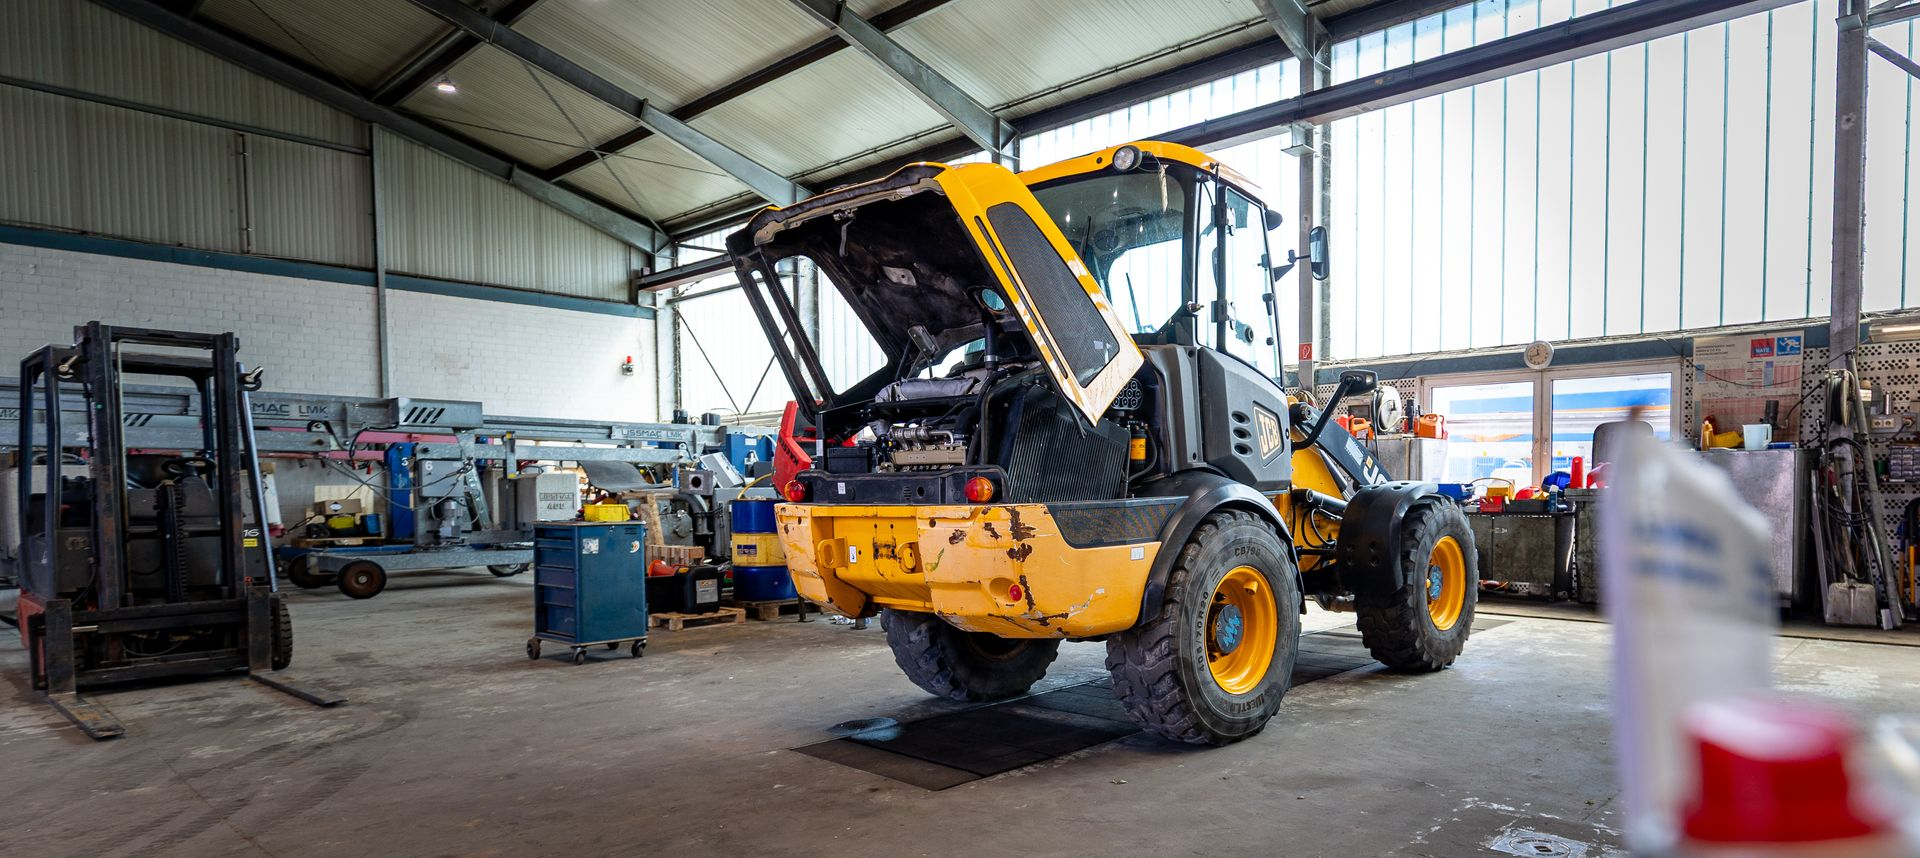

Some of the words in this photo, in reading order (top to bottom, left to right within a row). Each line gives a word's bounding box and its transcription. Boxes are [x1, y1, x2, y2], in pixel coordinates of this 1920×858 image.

[252, 402, 290, 414] MAC
[0, 410, 18, 419] MK
[1258, 413, 1281, 450] JCB
[425, 460, 433, 471] 6
